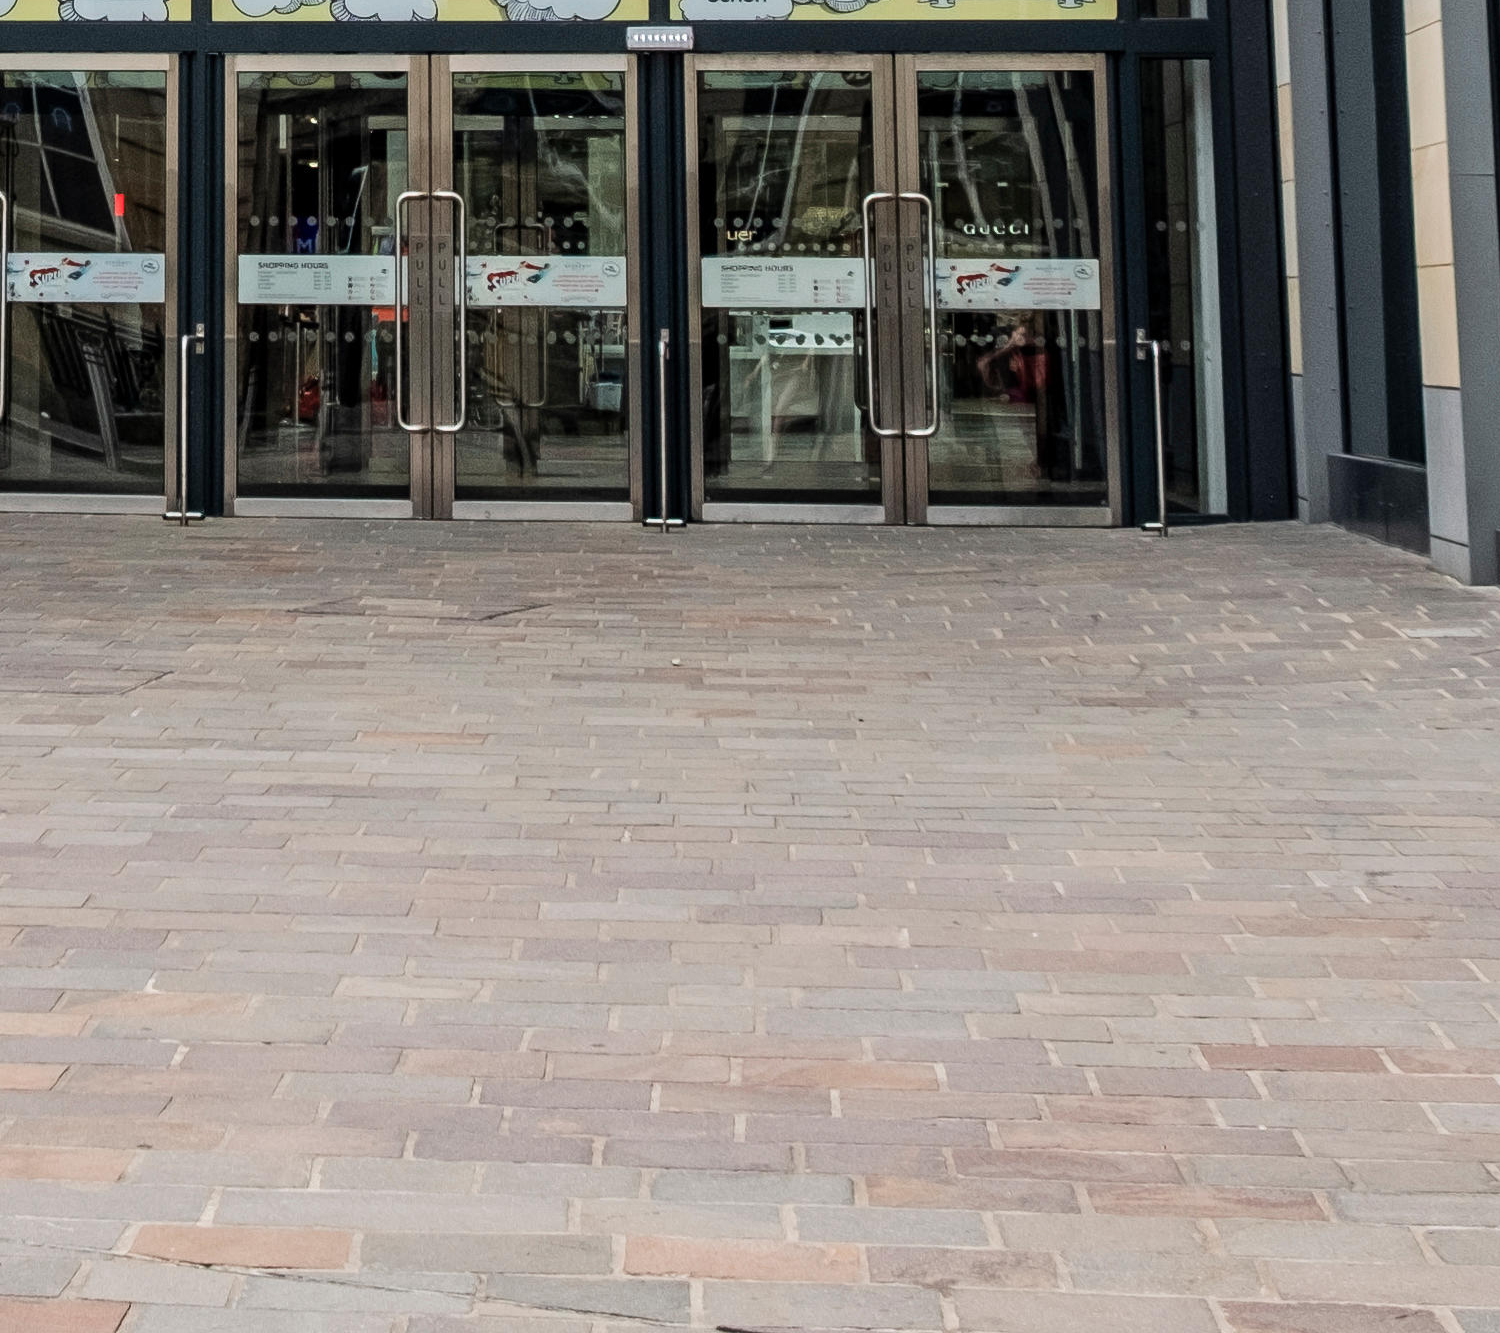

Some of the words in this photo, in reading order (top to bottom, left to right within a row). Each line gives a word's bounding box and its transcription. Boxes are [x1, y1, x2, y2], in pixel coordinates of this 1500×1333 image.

[963, 223, 1029, 235] GUCCI
[257, 262, 299, 270] SHOPPING
[301, 262, 329, 270] HOURS
[415, 241, 424, 306] PULL
[438, 241, 447, 306] PULL
[720, 264, 763, 273] SHOPPING
[764, 264, 795, 273] HOURS
[883, 243, 892, 309] PULL
[906, 243, 916, 309] PULL
